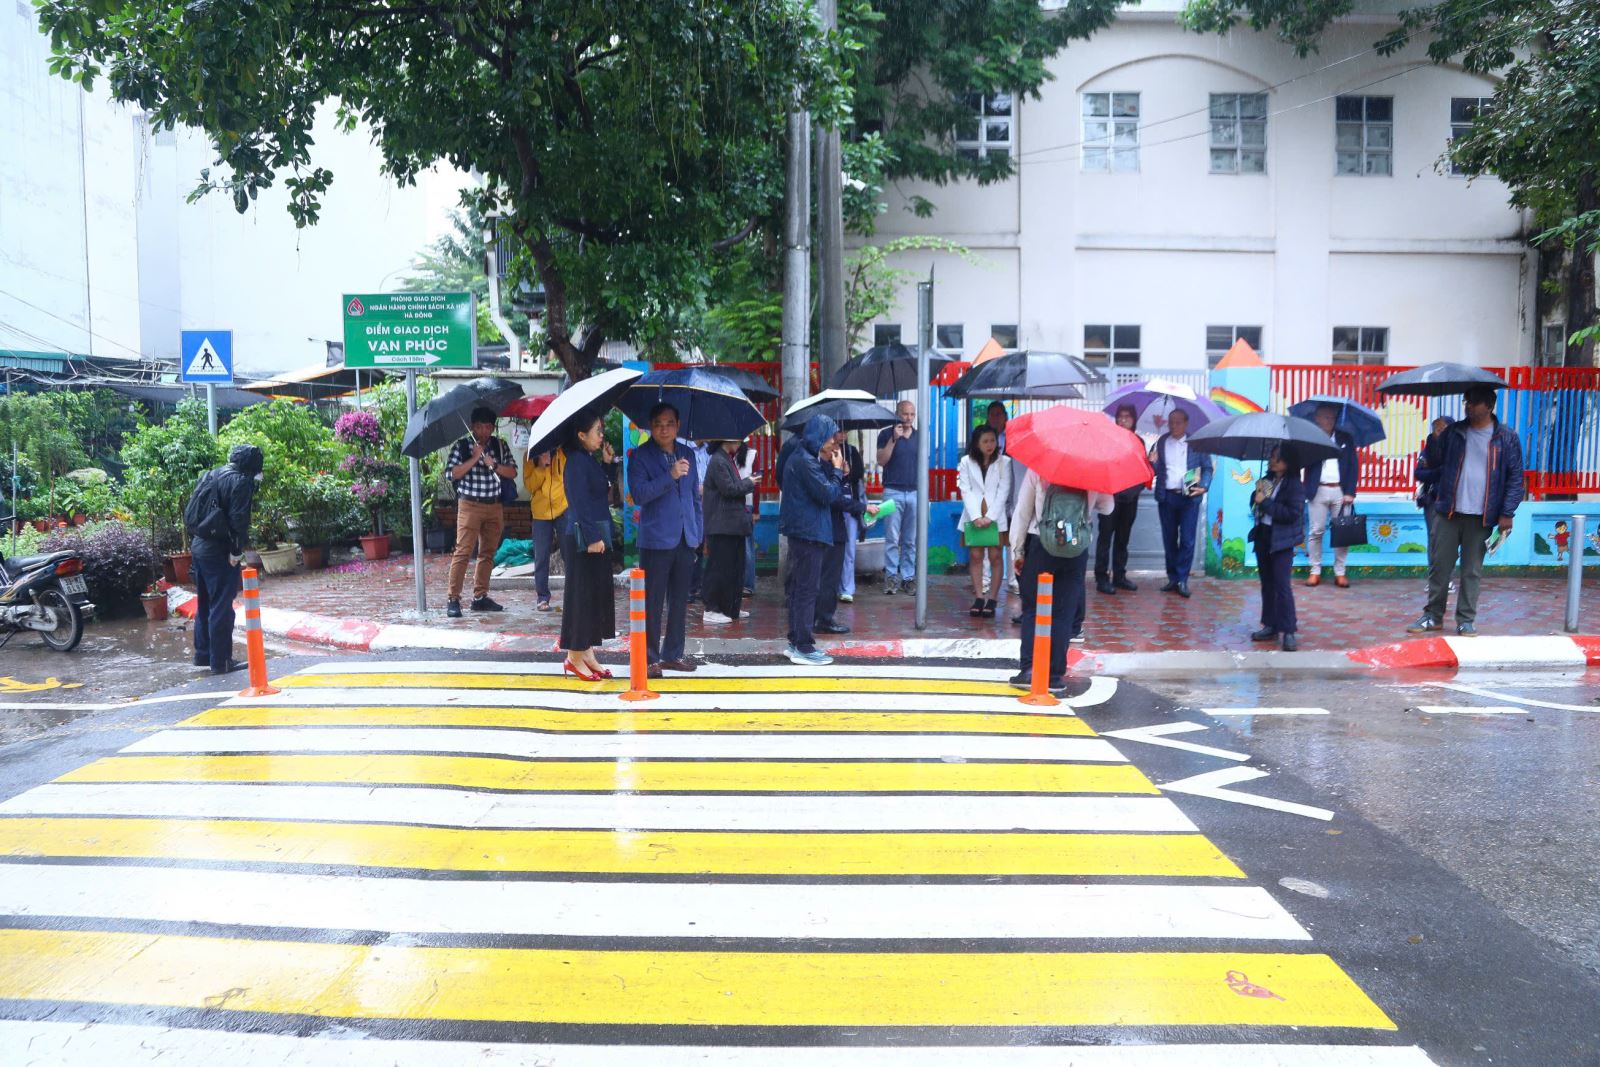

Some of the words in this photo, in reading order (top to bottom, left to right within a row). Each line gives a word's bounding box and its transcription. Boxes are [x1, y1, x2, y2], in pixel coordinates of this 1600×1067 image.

[389, 303, 406, 311] HÀNG
[404, 311, 413, 319] HÀ
[366, 322, 390, 335] ĐIỂM
[394, 325, 421, 335] GIAO
[424, 325, 449, 336] DỊCH
[368, 340, 400, 354] VẠN
[405, 337, 448, 351] PHÚC
